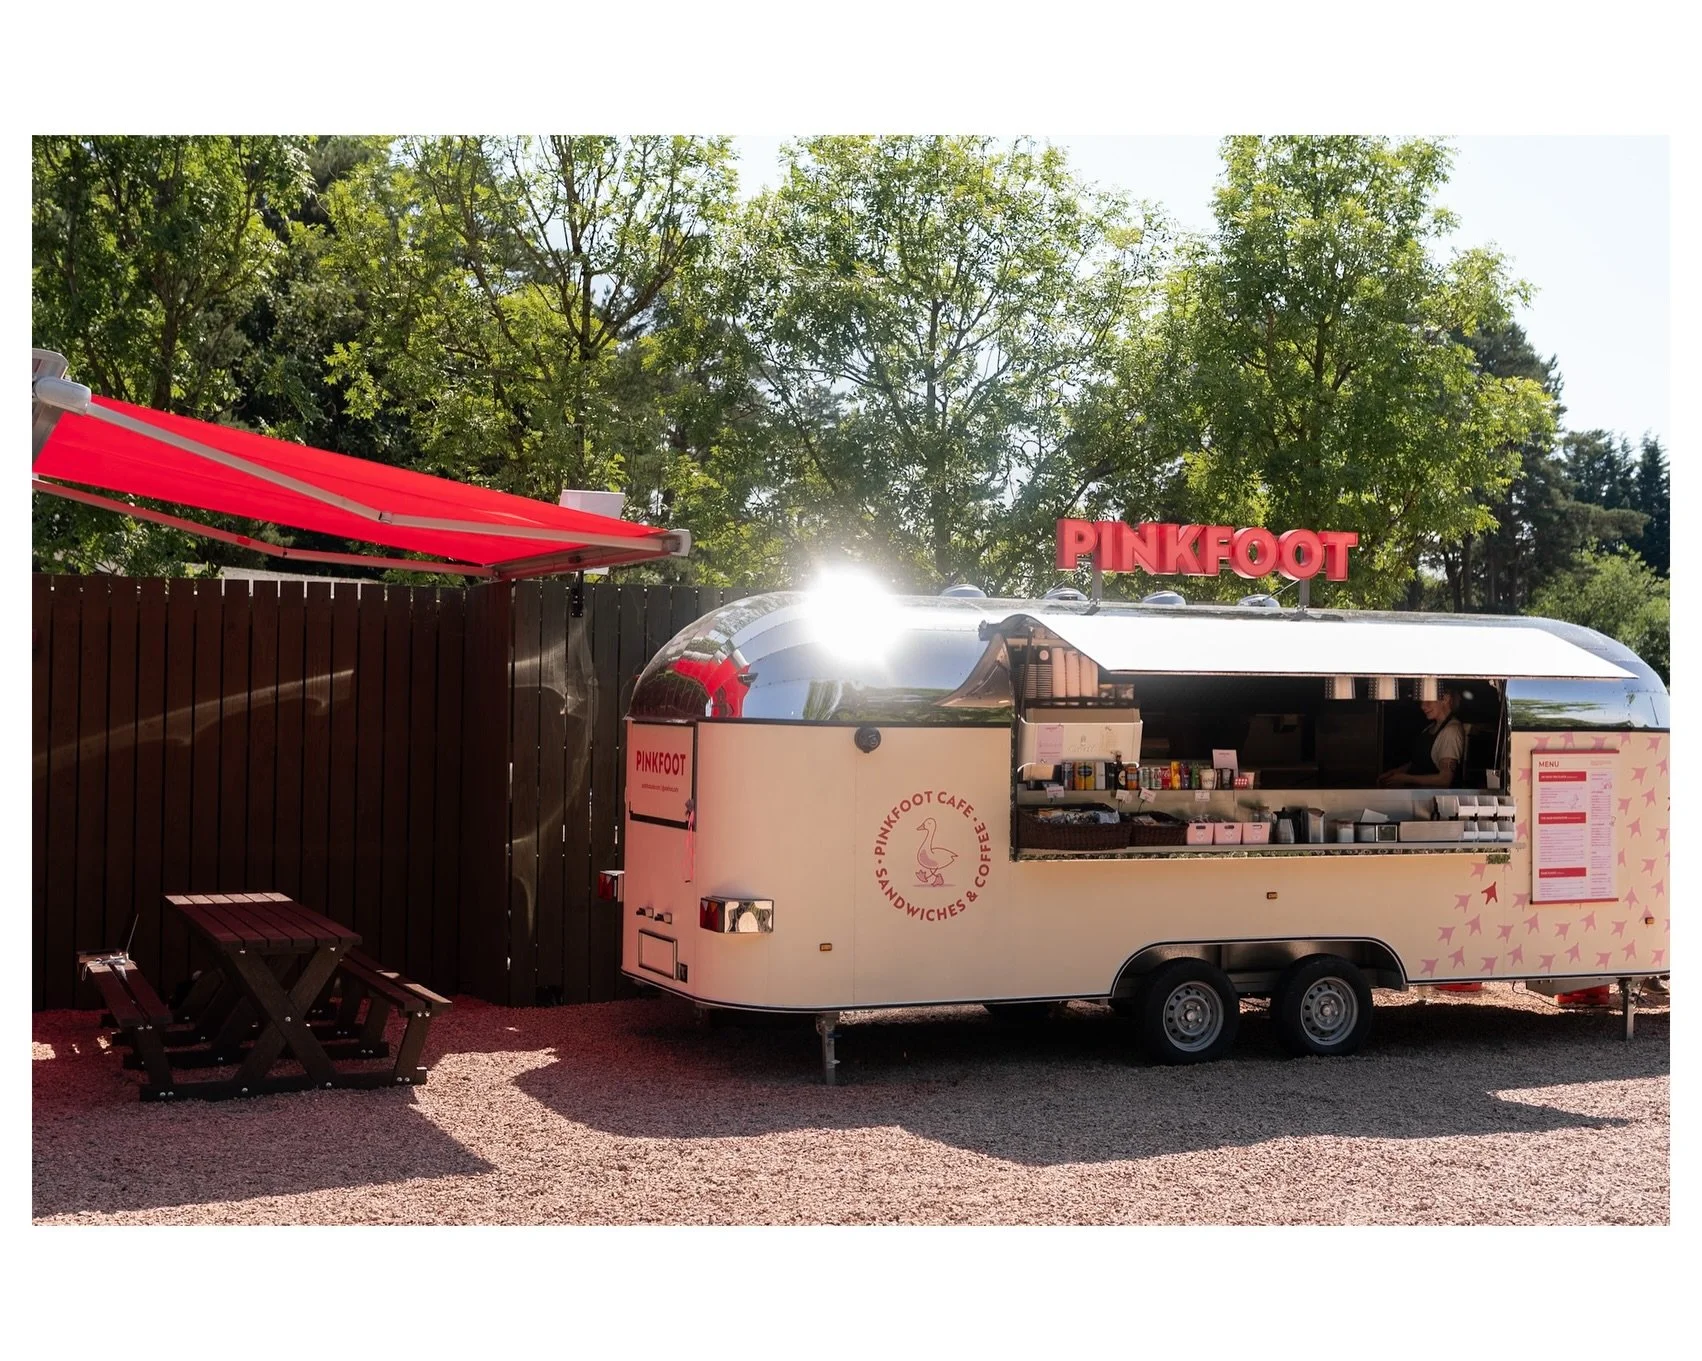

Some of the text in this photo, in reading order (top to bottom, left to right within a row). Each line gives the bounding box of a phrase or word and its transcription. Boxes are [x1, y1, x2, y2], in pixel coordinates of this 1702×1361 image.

[1056, 518, 1358, 582] PINKFOOT
[636, 750, 686, 776] PINKFOOT
[1538, 760, 1560, 768] MENU
[874, 790, 974, 856] PINKFOOT CAFE
[875, 822, 991, 922] SANDWICHES & COFFEE
